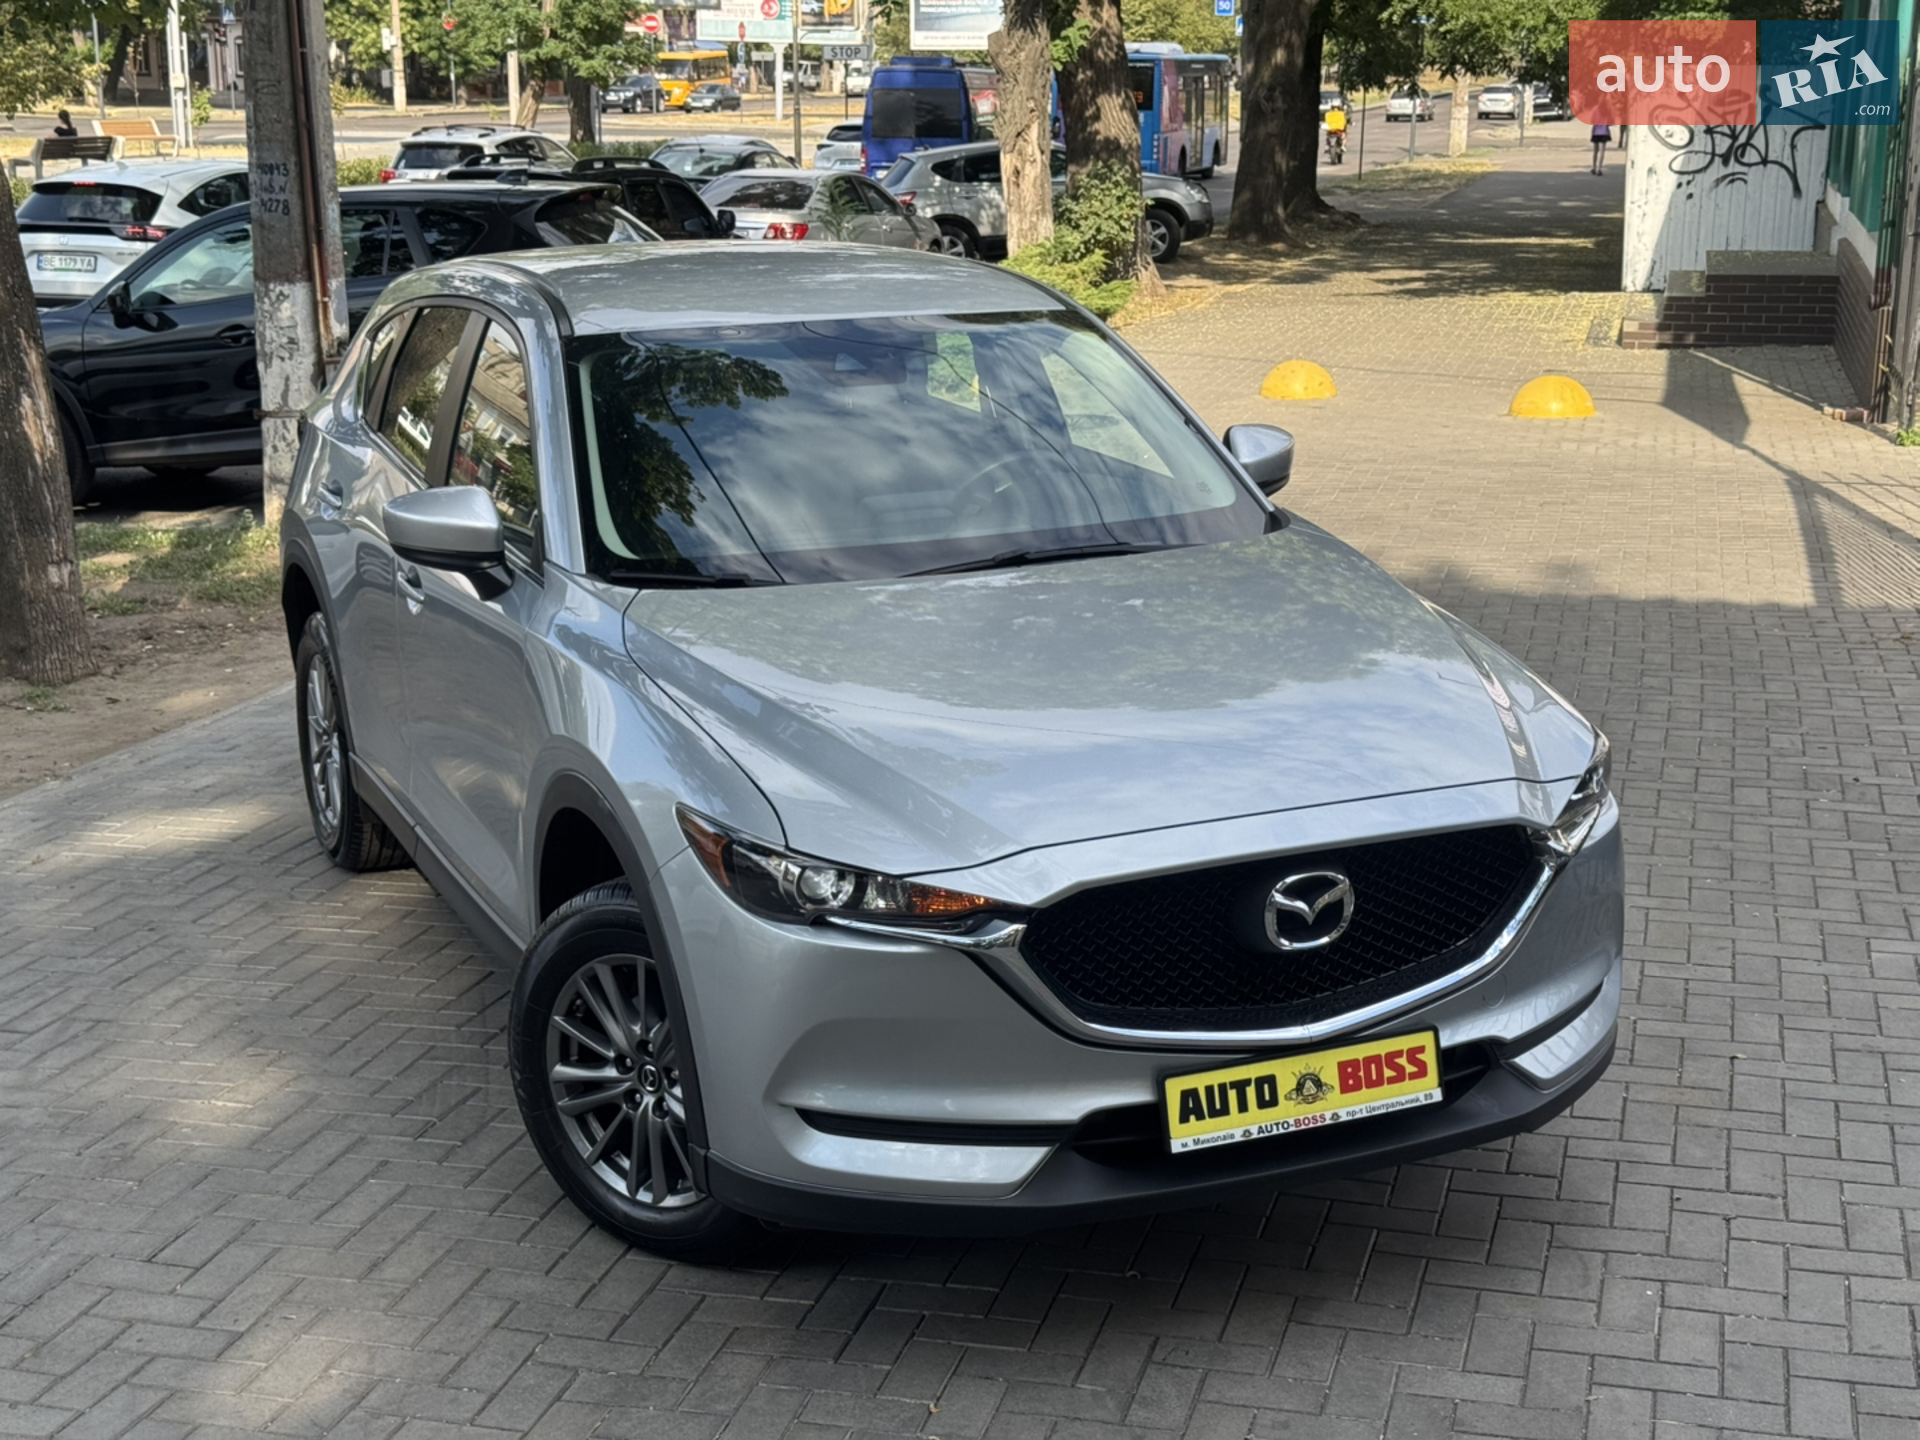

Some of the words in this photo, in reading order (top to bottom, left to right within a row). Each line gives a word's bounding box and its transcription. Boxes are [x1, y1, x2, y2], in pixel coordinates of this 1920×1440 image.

[830, 47, 861, 58] STOP
[261, 197, 290, 217] 4278
[43, 256, 57, 267] BE
[58, 257, 78, 268] 1179
[1178, 1074, 1279, 1124] AUTO
[1337, 1045, 1429, 1095] BOSS
[1345, 1107, 1364, 1119] пр-т
[1423, 1091, 1434, 1102] 89
[1256, 1113, 1327, 1137] AUTO-BOSS
[1192, 1132, 1236, 1148] Миколаїв
